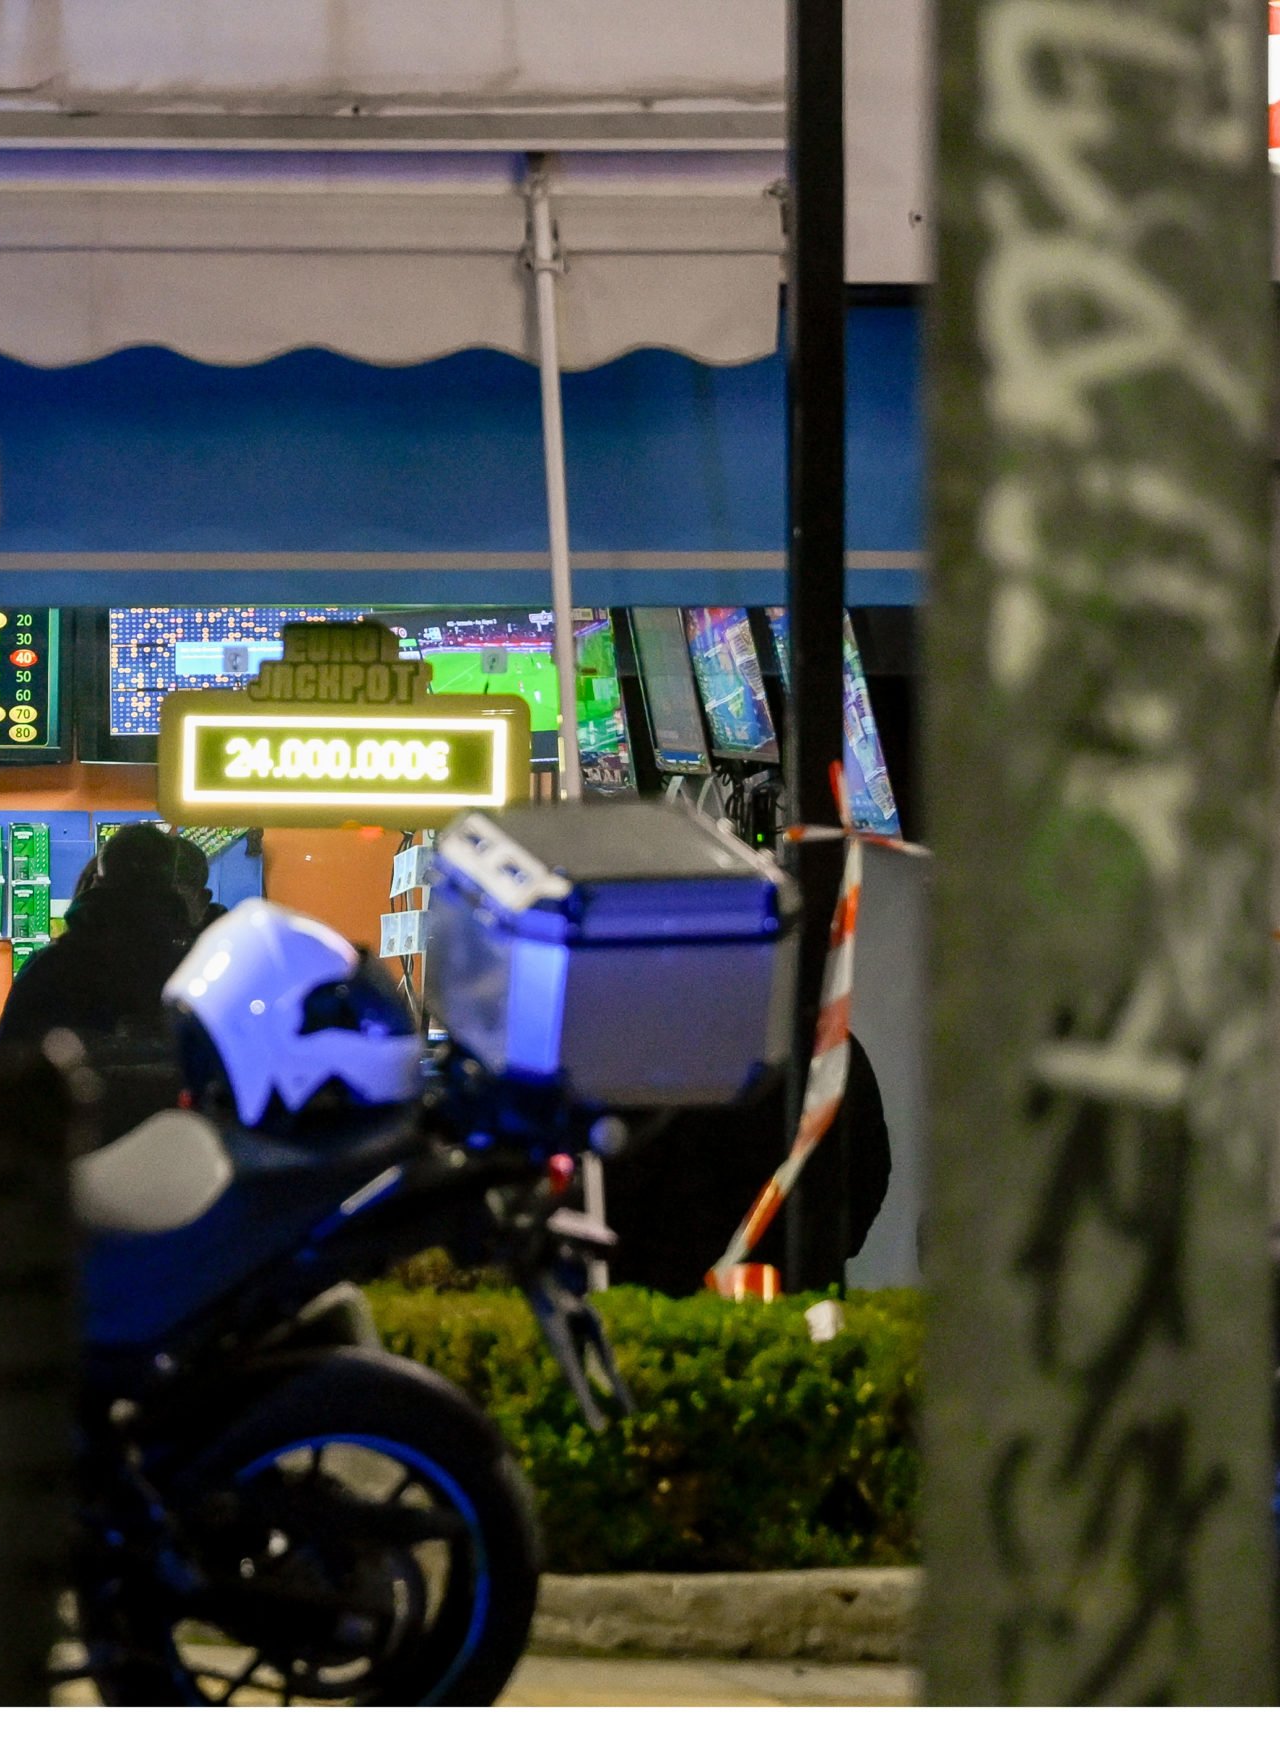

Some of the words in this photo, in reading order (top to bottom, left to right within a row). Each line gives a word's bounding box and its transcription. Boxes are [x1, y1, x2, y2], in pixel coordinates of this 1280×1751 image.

[17, 614, 32, 626] 20
[16, 633, 32, 645] 30
[16, 651, 32, 664] 40
[16, 671, 31, 682] 50
[250, 662, 417, 703] JACKPOT
[16, 689, 31, 701] 60
[16, 708, 31, 720] 70
[15, 727, 31, 738] 80
[224, 738, 450, 780] 24.000.000€
